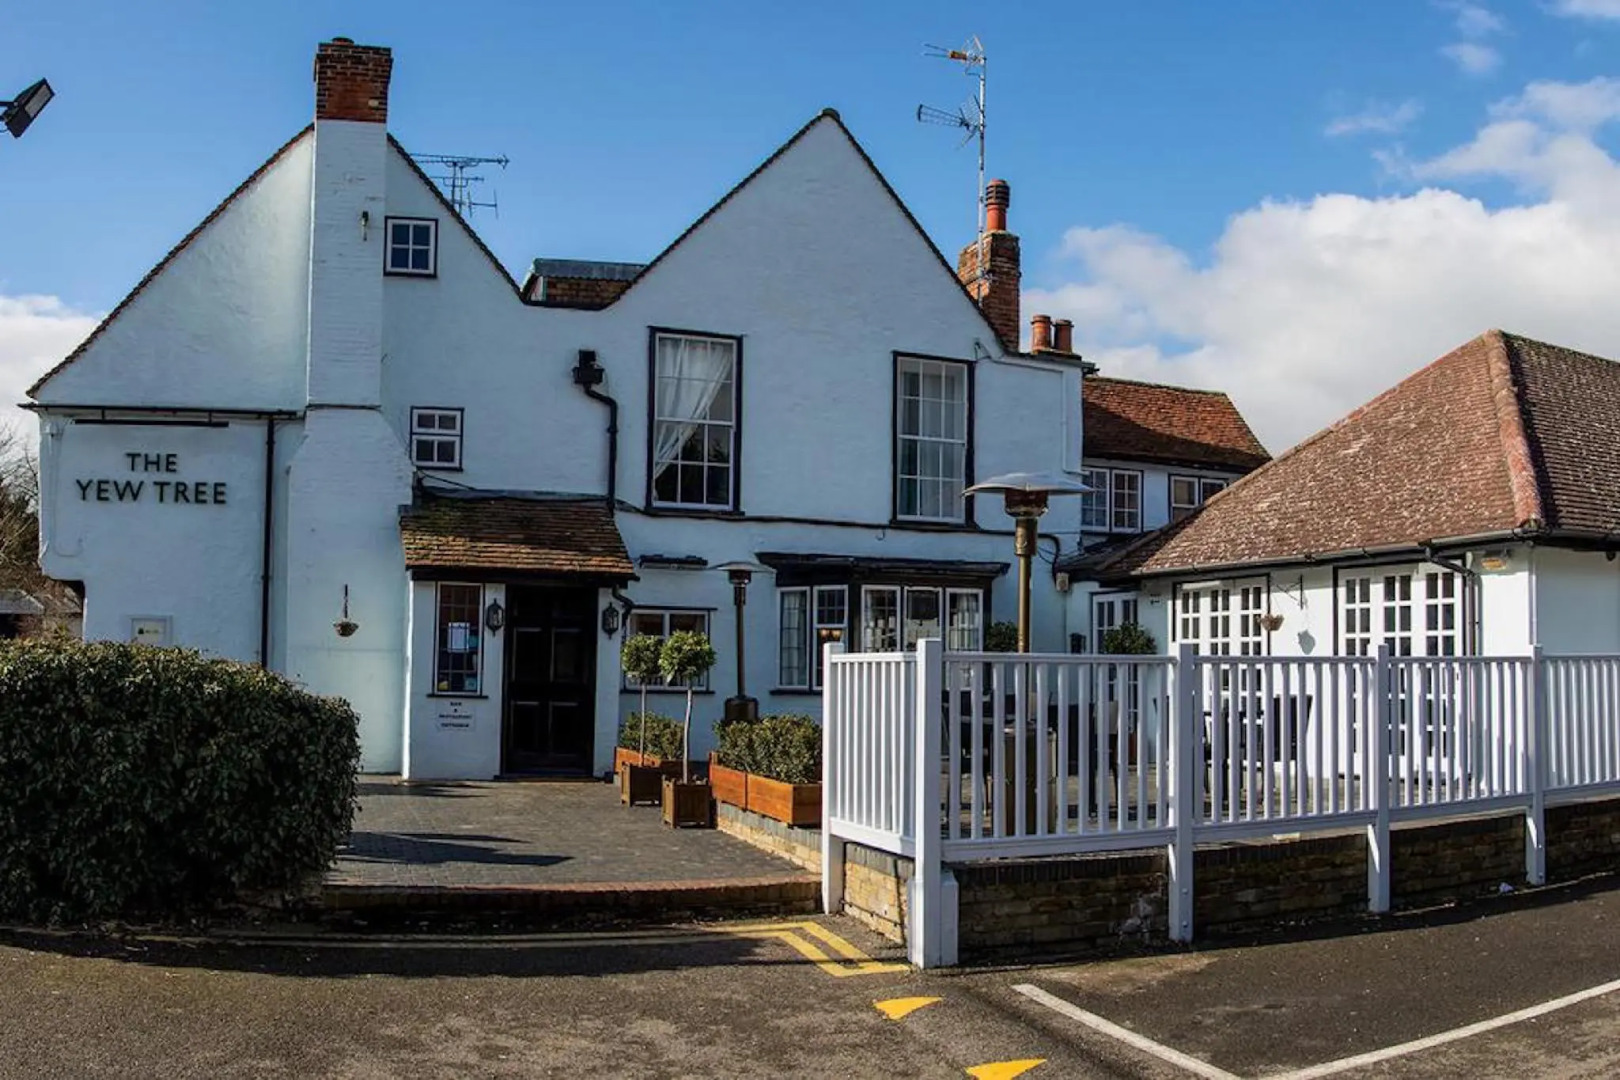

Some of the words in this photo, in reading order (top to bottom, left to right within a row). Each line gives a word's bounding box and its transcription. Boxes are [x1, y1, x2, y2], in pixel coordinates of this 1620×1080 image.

[125, 452, 179, 473] THE
[76, 478, 144, 502] YEW
[152, 480, 227, 505] TREE
